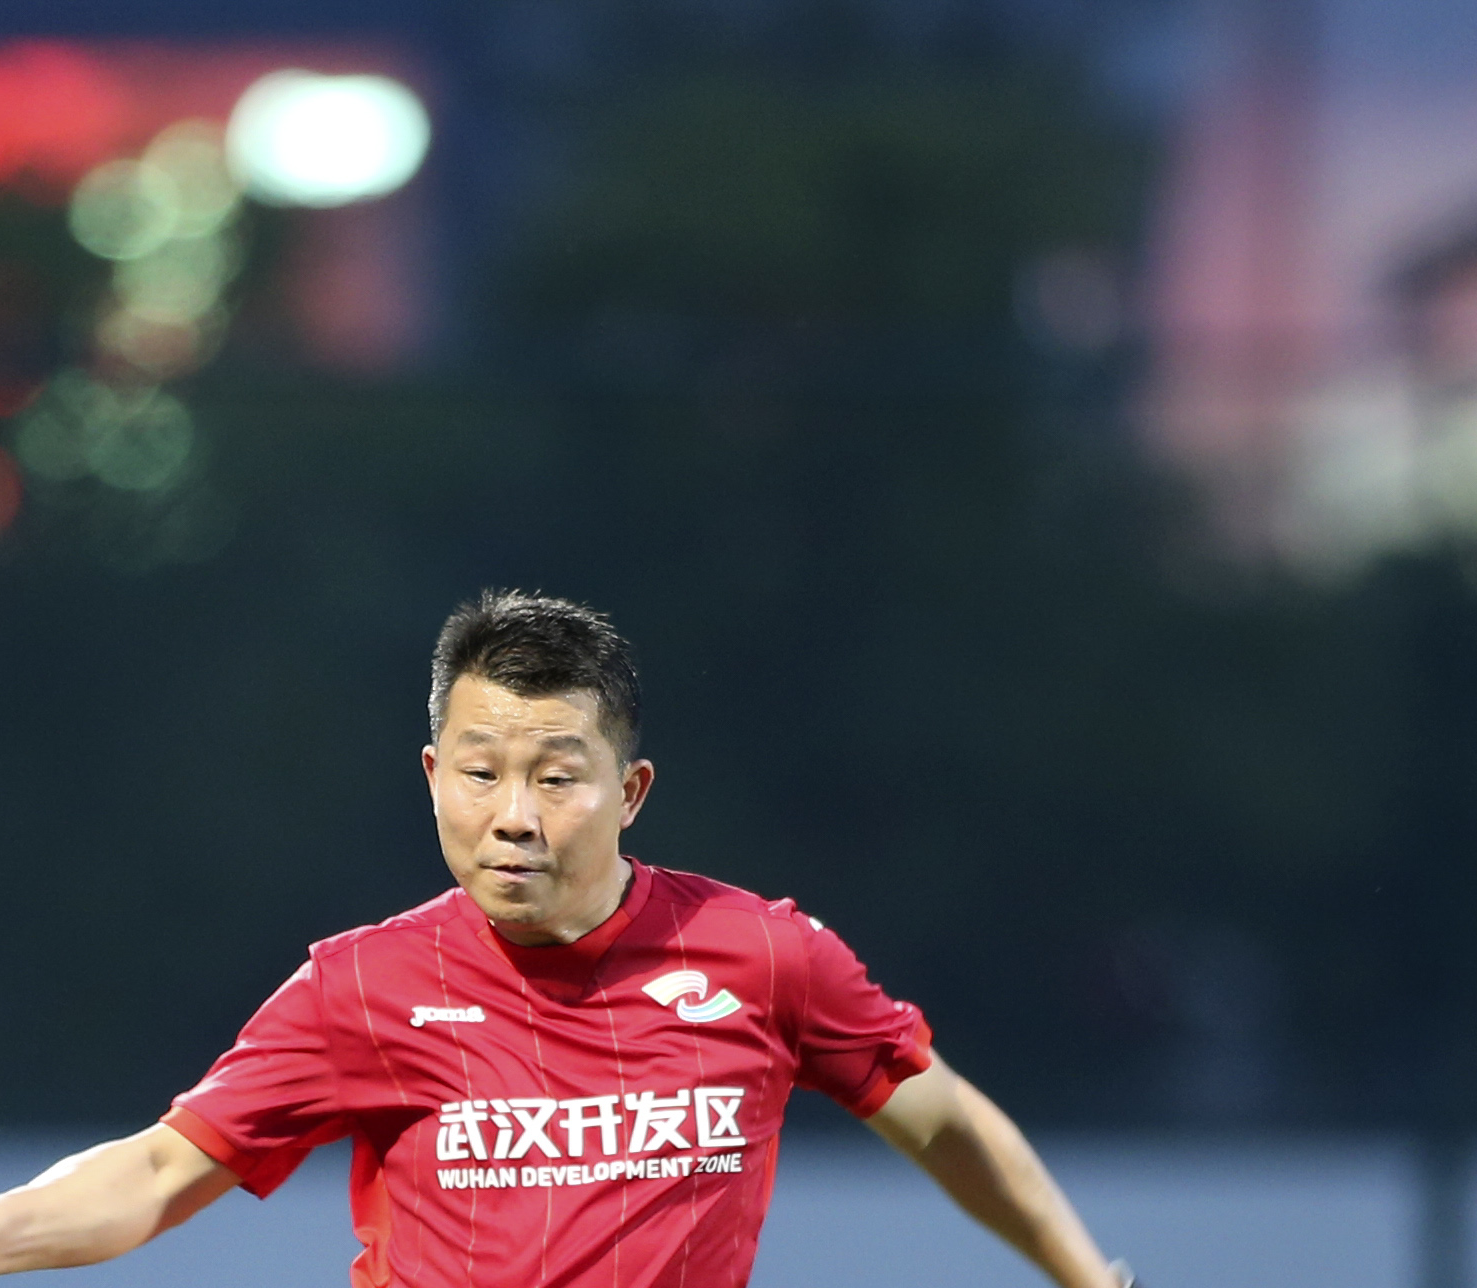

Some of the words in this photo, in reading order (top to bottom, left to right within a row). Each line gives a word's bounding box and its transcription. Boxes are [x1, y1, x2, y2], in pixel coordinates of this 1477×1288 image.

[436, 1086, 747, 1161] 武汉开发区
[436, 1166, 518, 1189] WUHAN
[520, 1155, 694, 1188] DEVELOPMENT
[693, 1152, 743, 1174] ZONE
